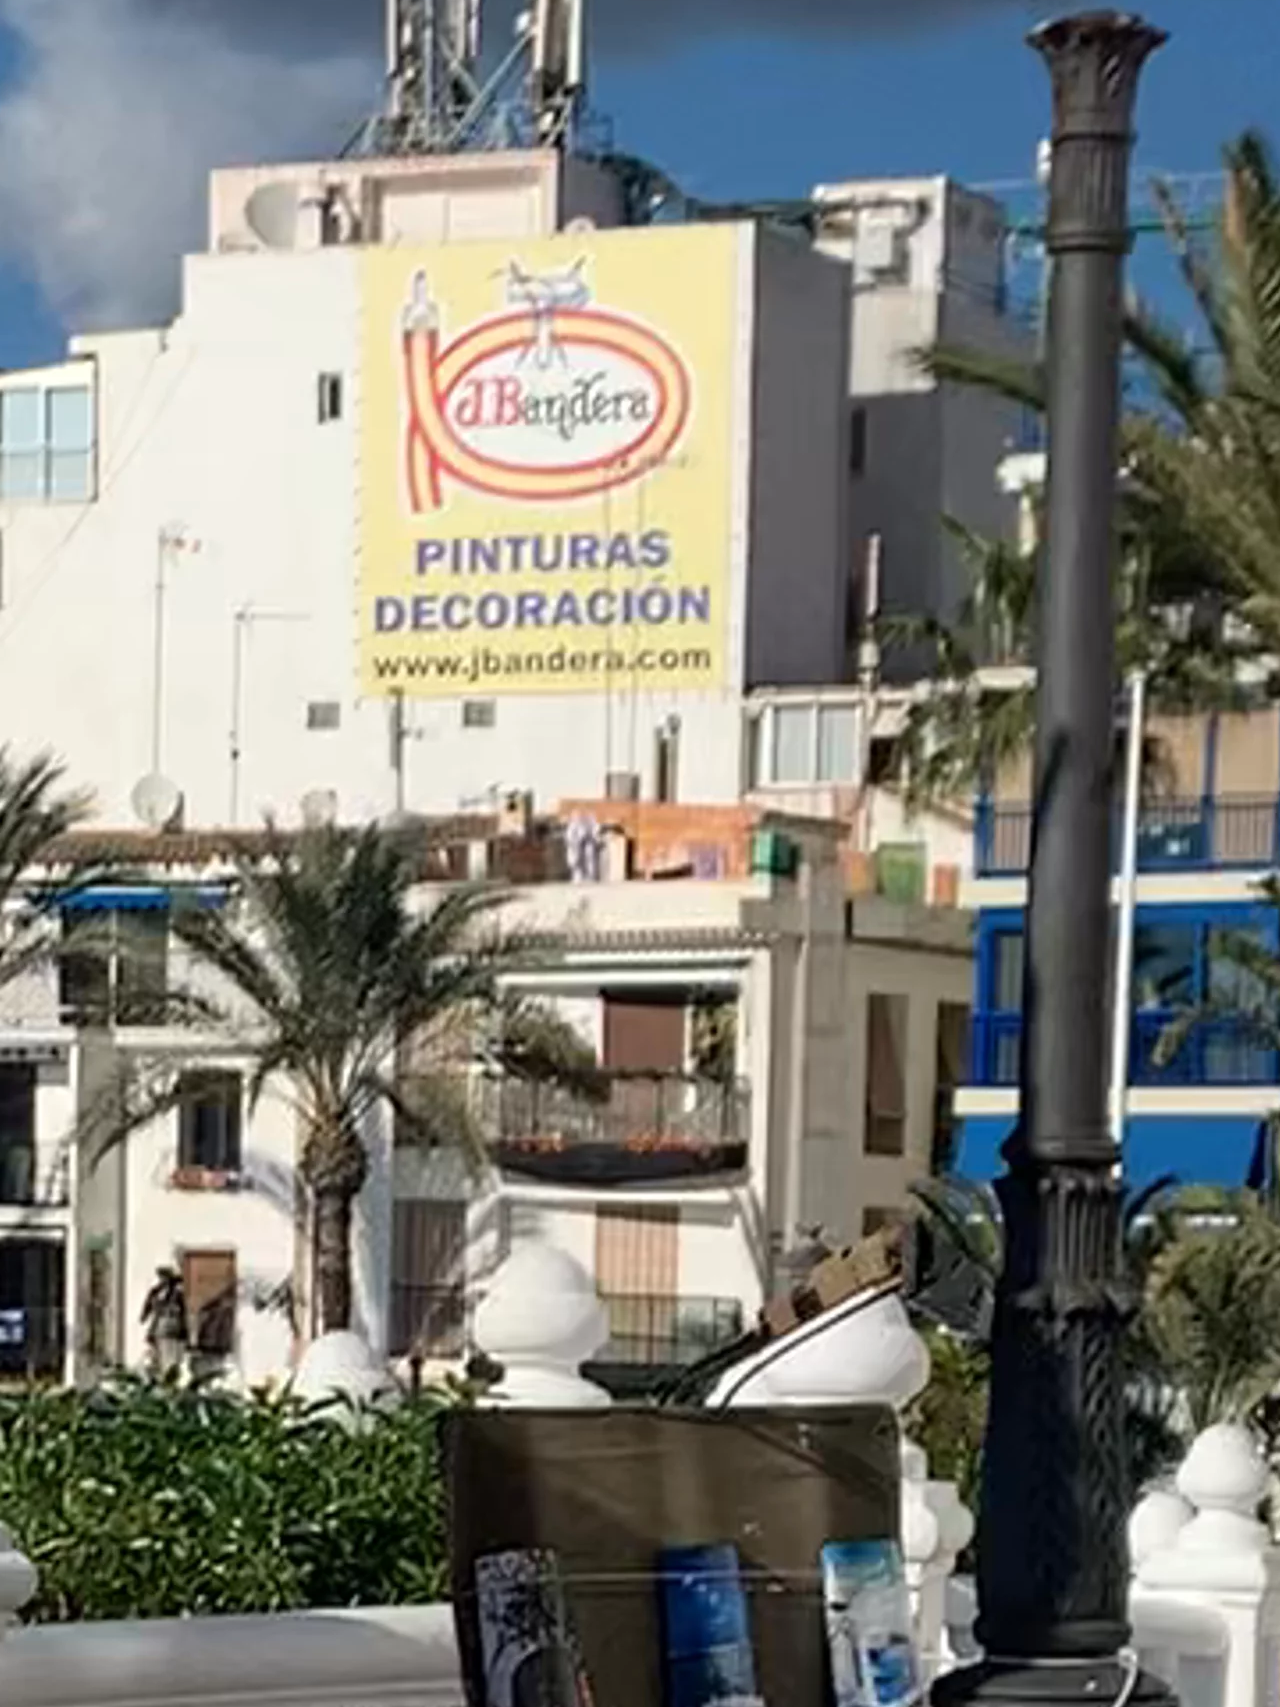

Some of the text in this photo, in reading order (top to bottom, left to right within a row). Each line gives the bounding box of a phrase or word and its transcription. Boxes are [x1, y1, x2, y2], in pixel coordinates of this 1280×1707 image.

[415, 529, 672, 576] PINTURAS
[373, 574, 711, 633] DECORACIÓN
[372, 642, 712, 683] www.jbandera.com
